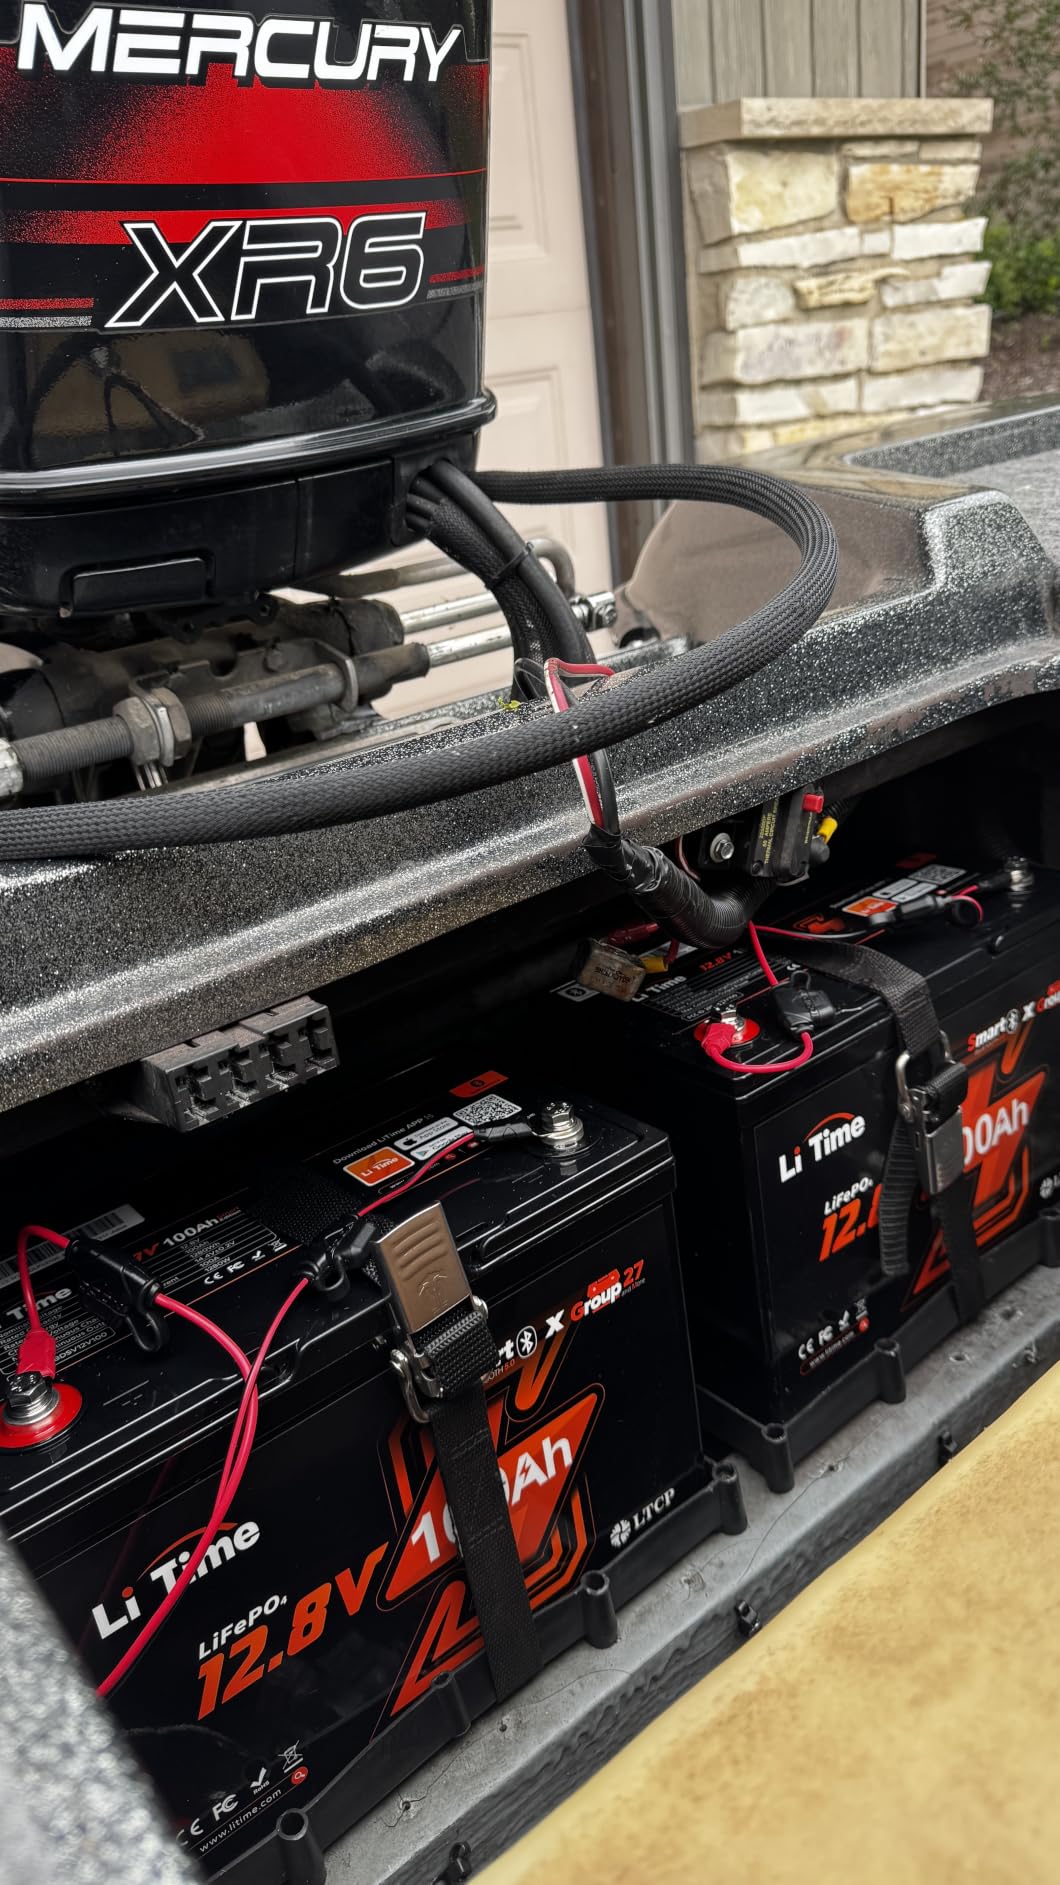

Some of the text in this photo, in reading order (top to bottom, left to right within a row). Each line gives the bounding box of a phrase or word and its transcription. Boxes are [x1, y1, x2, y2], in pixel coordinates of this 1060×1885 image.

[17, 2, 461, 82] MERCURY
[103, 212, 426, 327] XR6
[764, 838, 772, 864] THERMAL
[645, 976, 688, 993] Time
[967, 1017, 1007, 1052] Smart
[333, 1140, 377, 1165] Download
[406, 1117, 424, 1130] App
[374, 1156, 399, 1172] Time
[778, 1115, 865, 1183] Li Time
[162, 1217, 220, 1247] 100Ah
[204, 1272, 224, 1284] CE
[570, 1282, 622, 1322] Group
[623, 1259, 644, 1288] 27
[633, 1487, 676, 1530] LTCP
[92, 1521, 260, 1640] Li Time
[197, 1541, 389, 1721] 12.8V
[199, 1788, 283, 1853] www.litime.com
